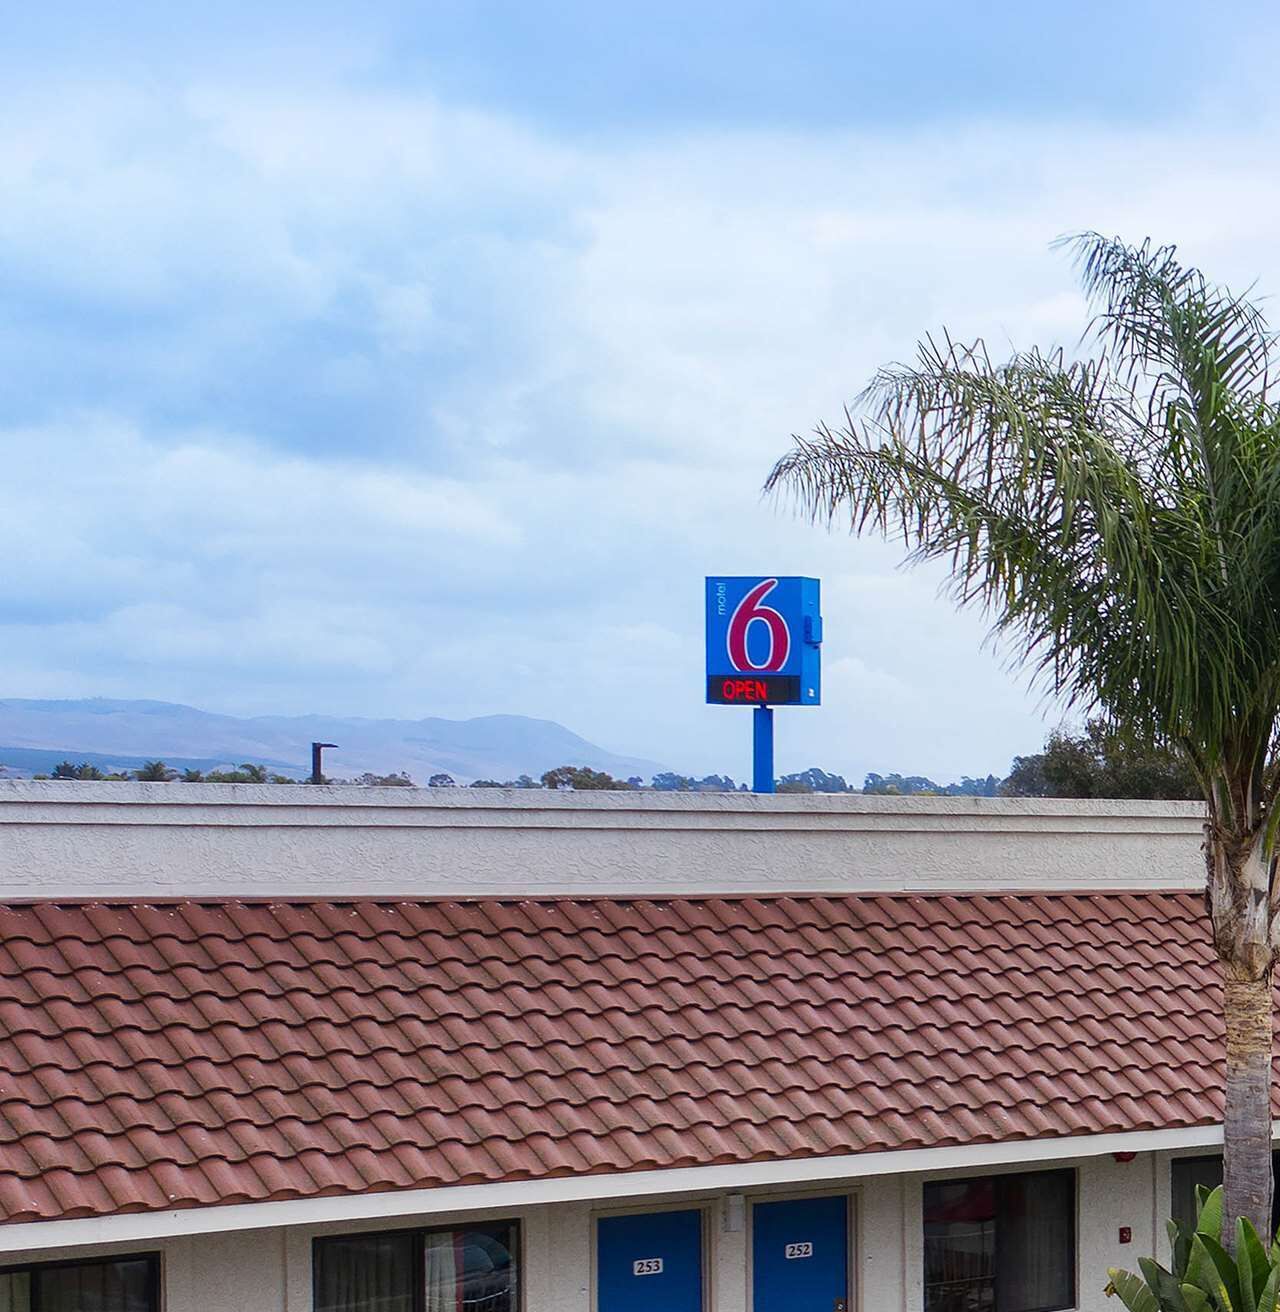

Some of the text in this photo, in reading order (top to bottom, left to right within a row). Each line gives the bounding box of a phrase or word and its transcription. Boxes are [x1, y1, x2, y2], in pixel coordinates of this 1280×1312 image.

[717, 582, 726, 616] motel
[726, 577, 791, 672] 6
[723, 680, 767, 701] OPEN
[788, 1243, 811, 1257] 252
[636, 1260, 661, 1274] 253
